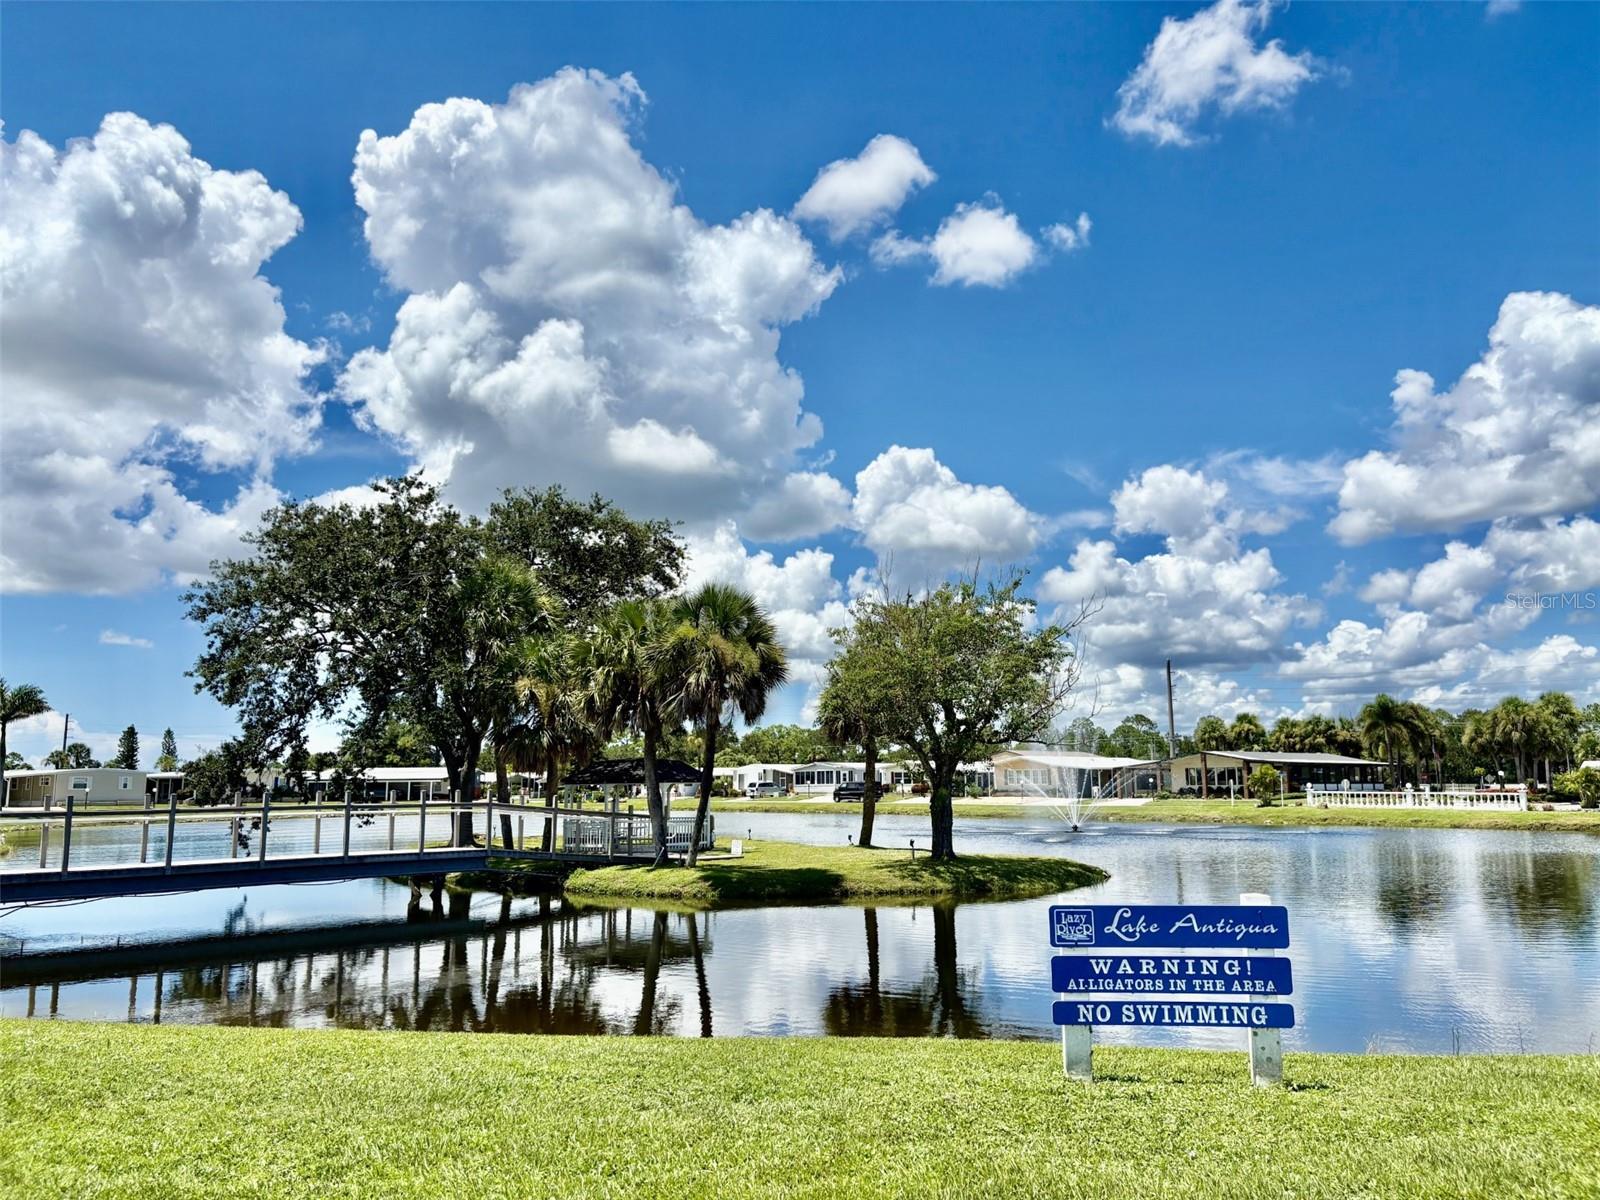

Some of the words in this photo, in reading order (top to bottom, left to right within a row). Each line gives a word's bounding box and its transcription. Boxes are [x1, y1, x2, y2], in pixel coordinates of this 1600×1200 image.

[1061, 912, 1087, 925] Lazy
[1104, 908, 1160, 942] Lake
[1169, 913, 1279, 941] Antigua
[1089, 958, 1252, 976] WARNING!
[1067, 978, 1164, 991] ALLIGATORS
[1169, 979, 1187, 991] IN
[1193, 980, 1226, 992] THE
[1232, 980, 1277, 993] AREA
[1077, 1004, 1111, 1023] NO
[1122, 1004, 1268, 1025] SWIMMING
